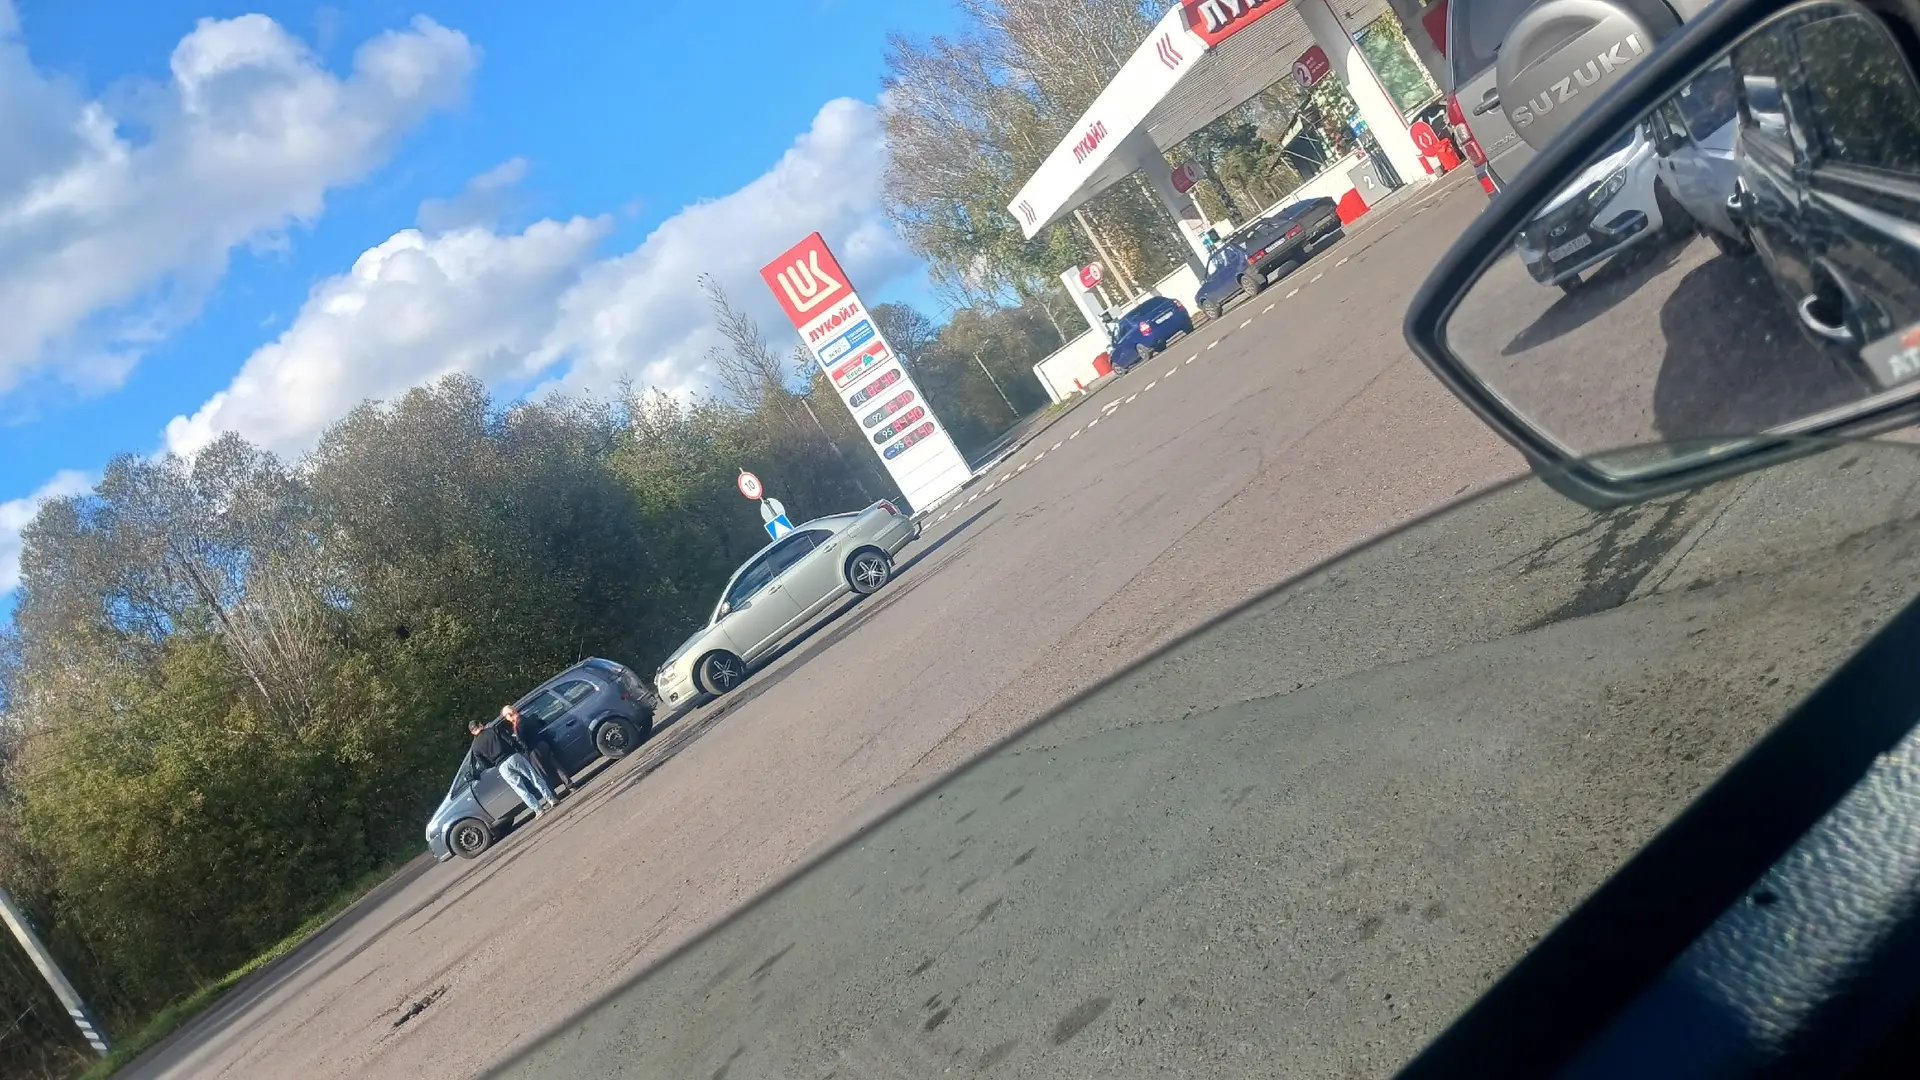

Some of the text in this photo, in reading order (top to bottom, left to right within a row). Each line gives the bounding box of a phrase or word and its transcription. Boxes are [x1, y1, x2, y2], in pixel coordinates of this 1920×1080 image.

[1512, 32, 1644, 128] SUZUKI
[1072, 119, 1108, 164] ЛУКОЙЛ
[808, 302, 860, 342] ЛУКОЙЛ
[872, 412, 882, 423] 92
[882, 428, 893, 438] 95
[894, 441, 905, 451] 95
[744, 479, 756, 492] 10
